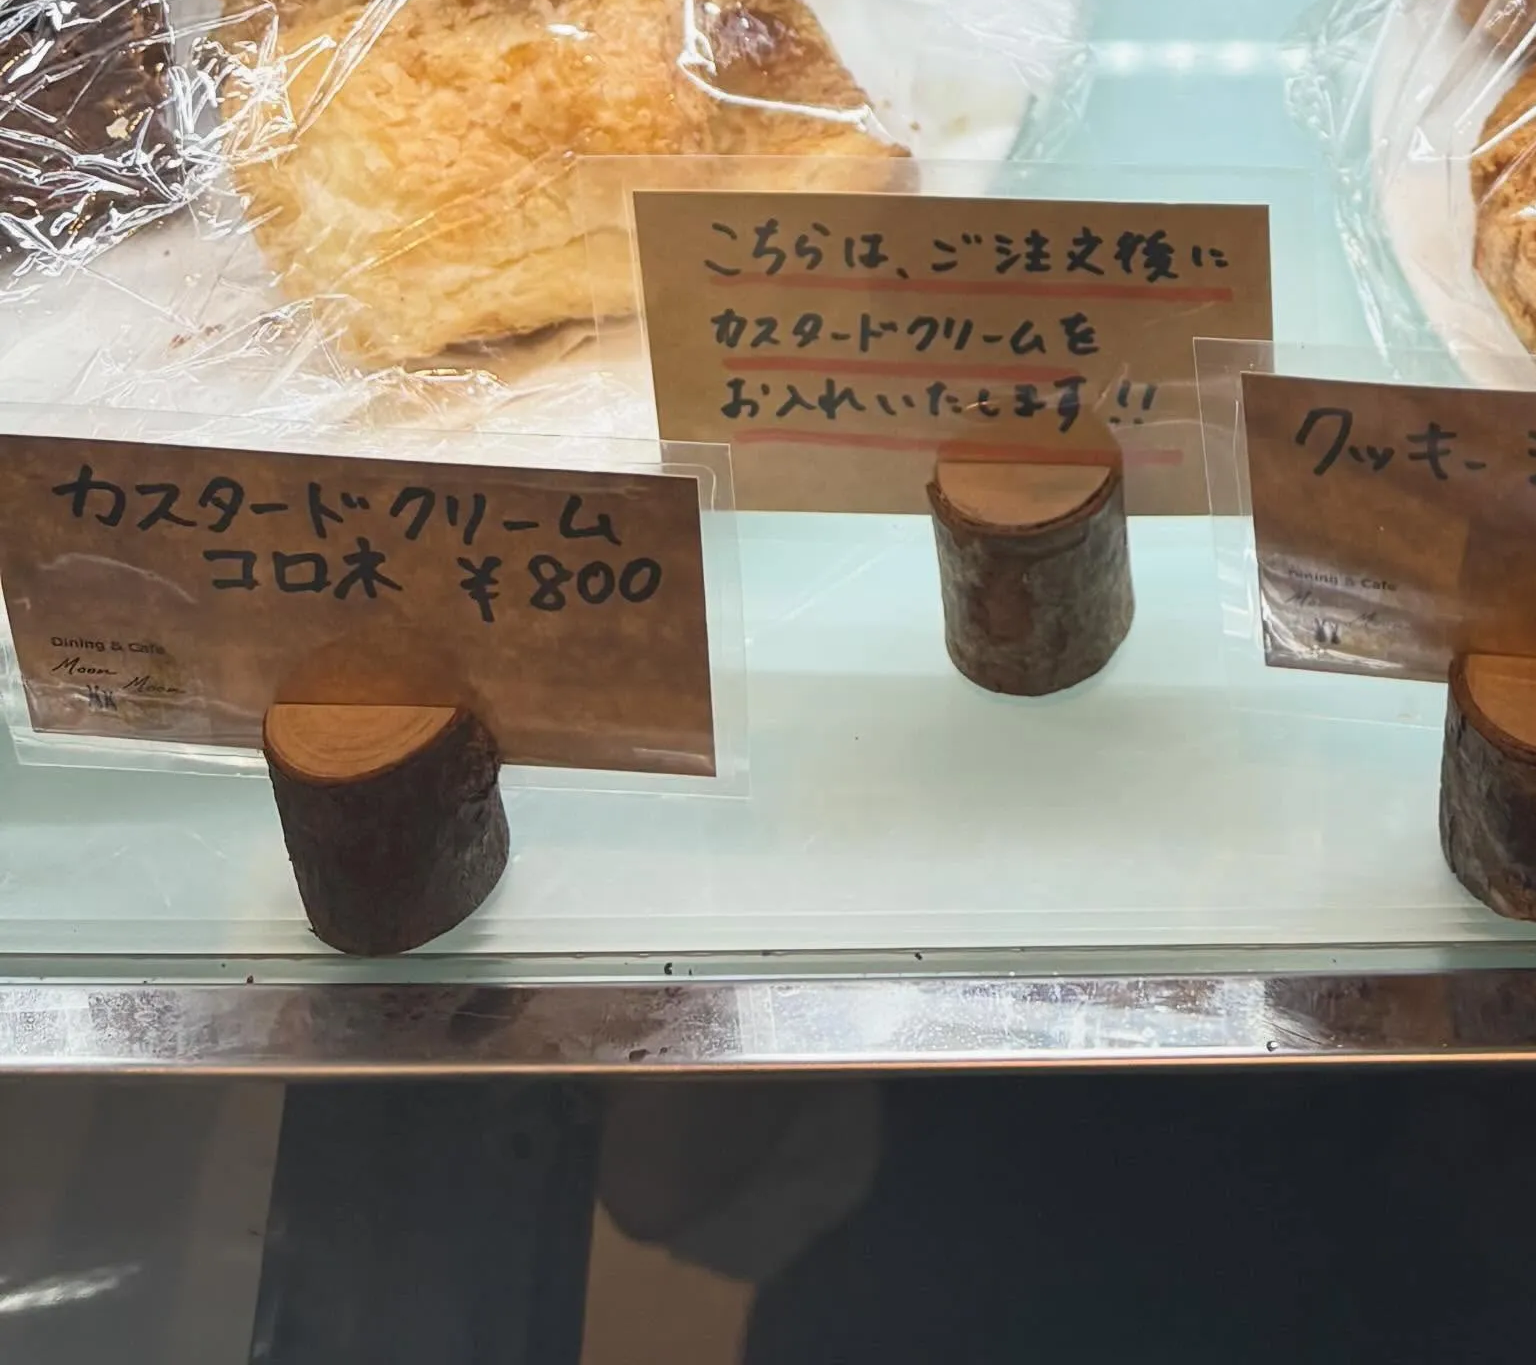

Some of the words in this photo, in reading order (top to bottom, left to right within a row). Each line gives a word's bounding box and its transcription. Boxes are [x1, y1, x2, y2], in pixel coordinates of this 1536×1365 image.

[711, 308, 1100, 355] カスタードクリームを
[52, 465, 623, 547] カスタードクリーム
[203, 537, 403, 601] コロネ
[457, 554, 663, 623] ¥800
[51, 635, 106, 653] Dining
[52, 657, 118, 676] Moon
[123, 675, 186, 694] Moon
